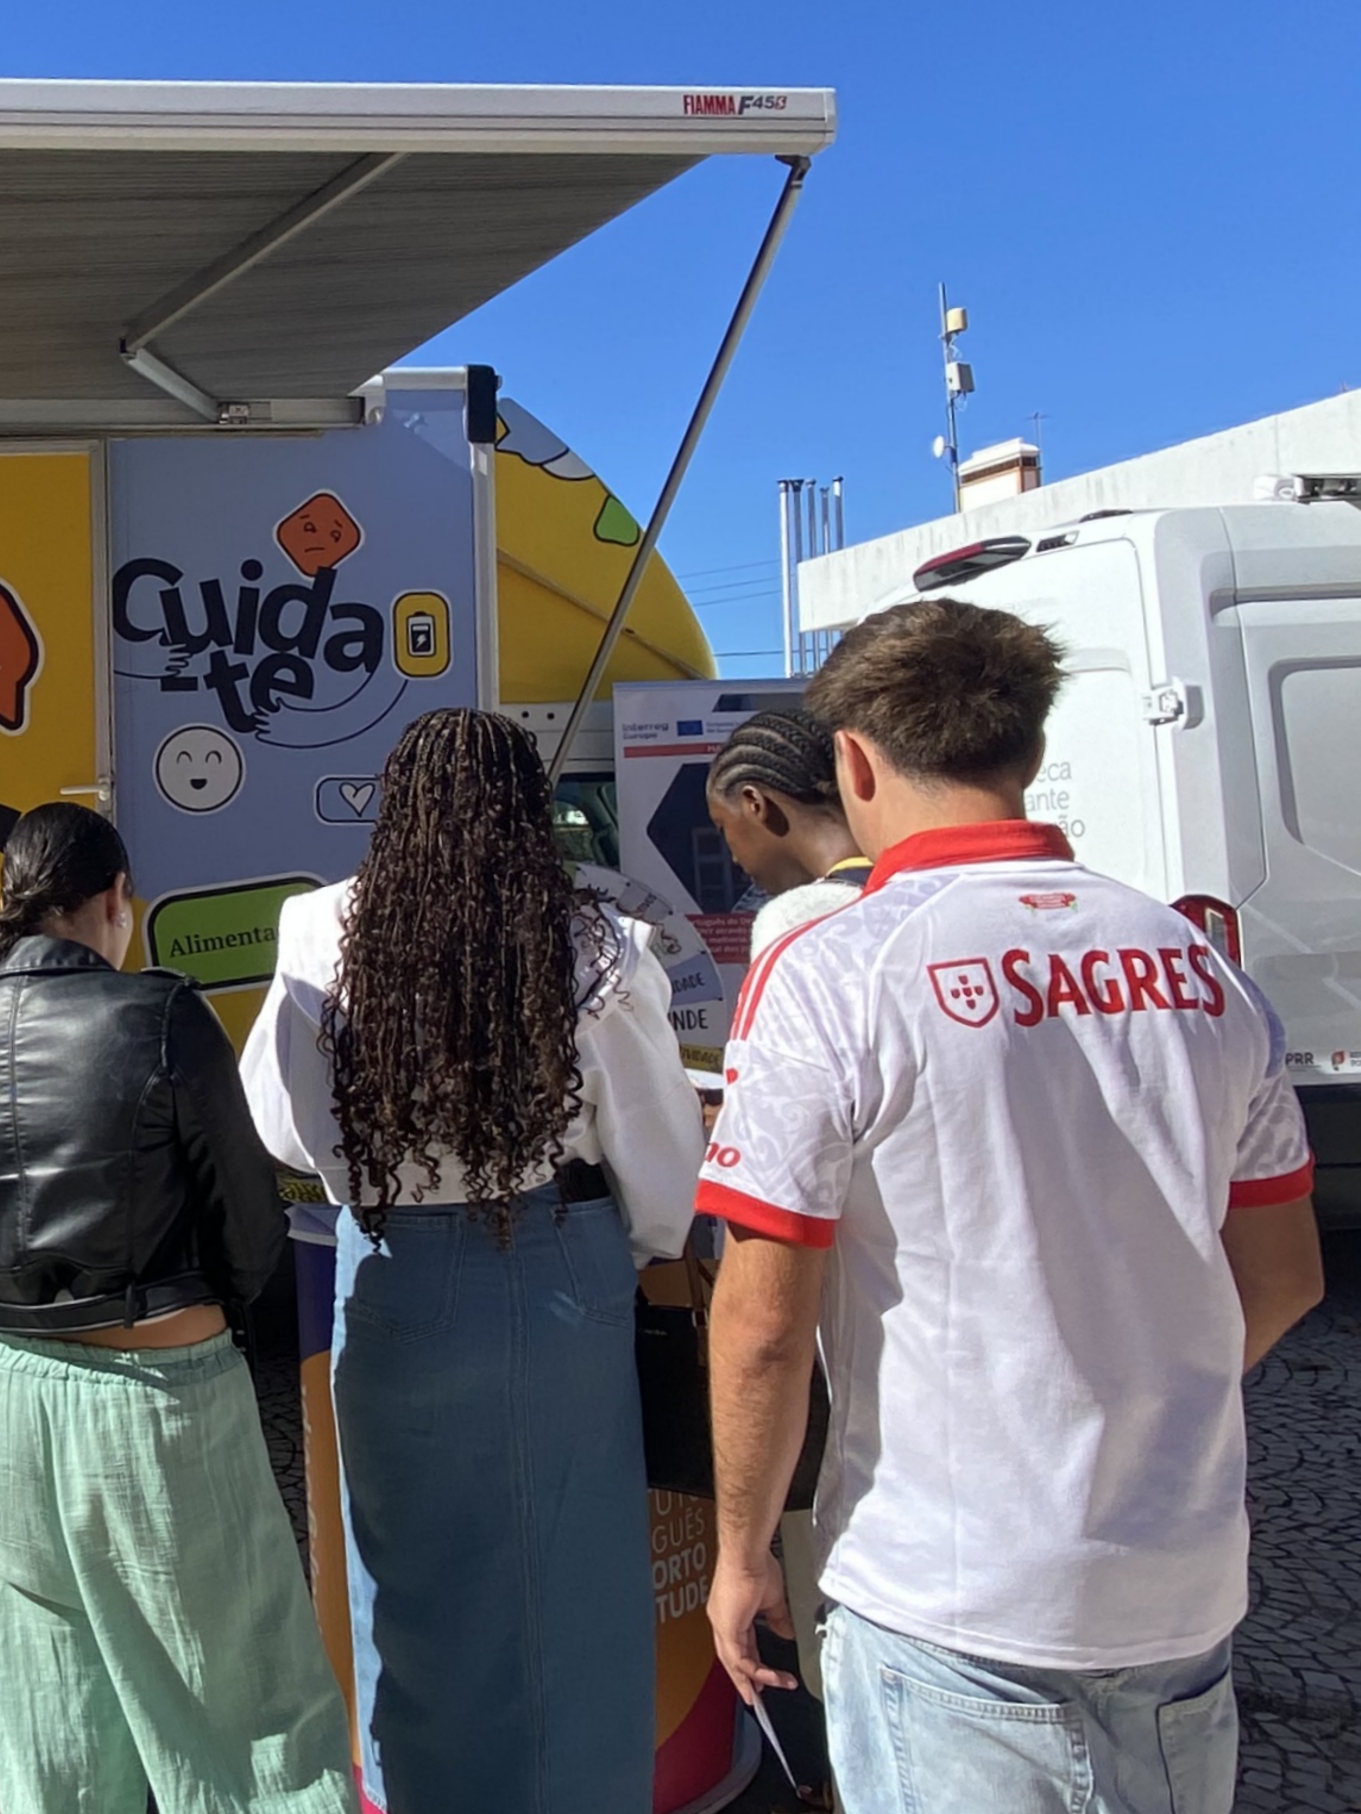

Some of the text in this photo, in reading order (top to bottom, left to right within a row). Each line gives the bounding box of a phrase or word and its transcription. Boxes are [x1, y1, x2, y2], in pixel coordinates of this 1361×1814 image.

[683, 95, 735, 116] FIAMMA
[111, 557, 384, 674] Cuida
[169, 926, 278, 959] Alimenta
[1001, 943, 1226, 1028] SAGRES
[1285, 1052, 1314, 1066] PRR
[652, 1507, 705, 1554] GUÊS
[652, 1541, 707, 1590] ORTO
[655, 1574, 709, 1624] TUDE
